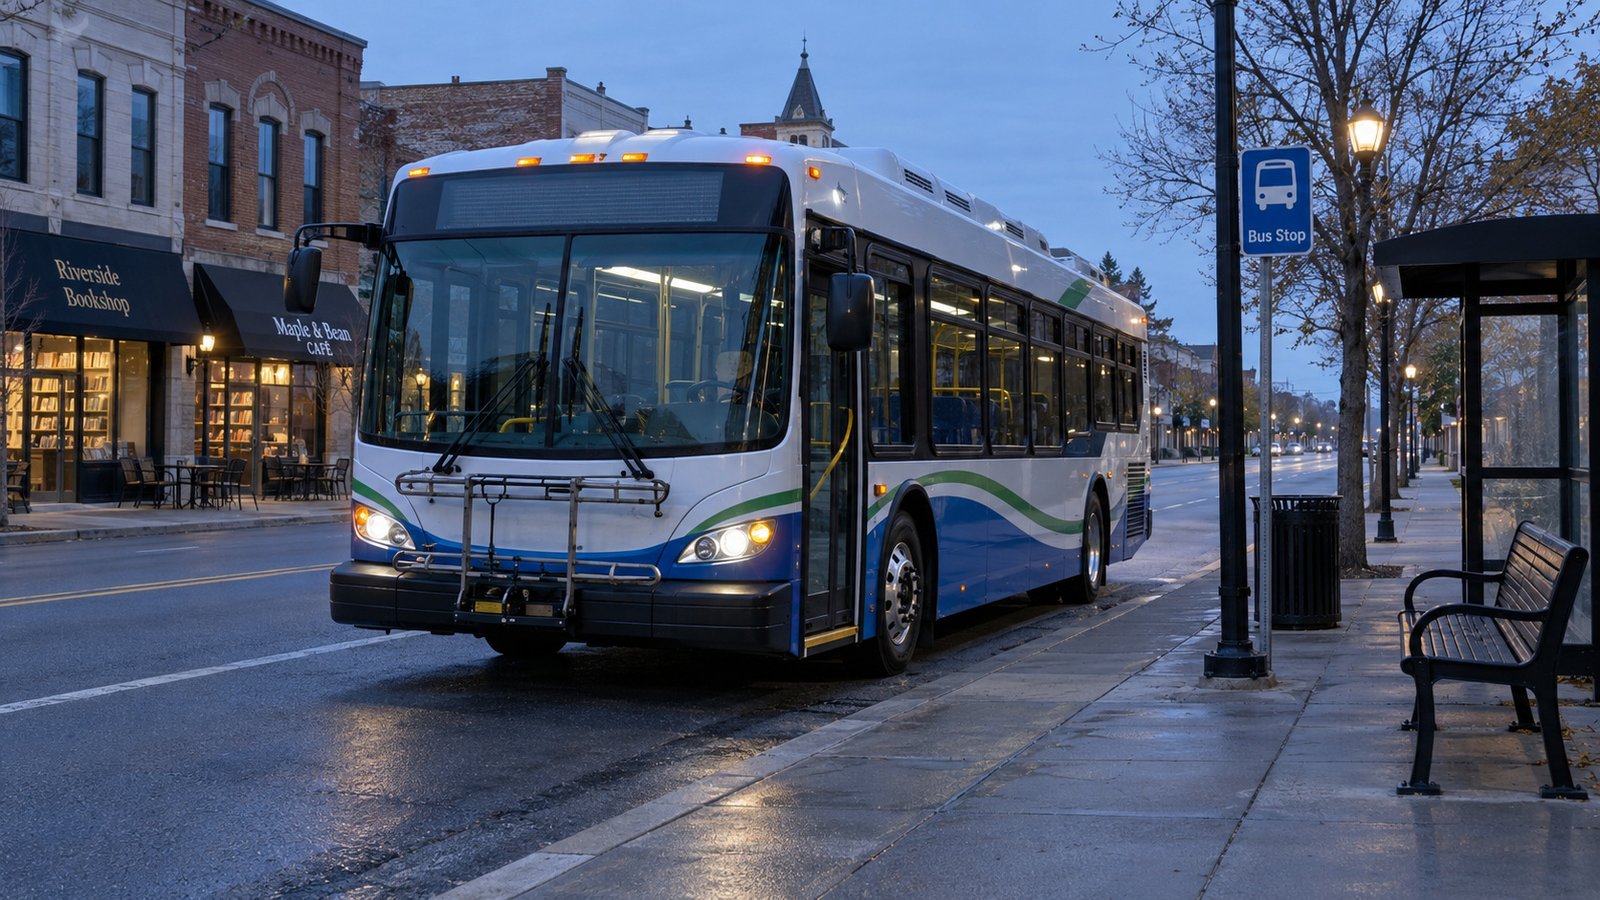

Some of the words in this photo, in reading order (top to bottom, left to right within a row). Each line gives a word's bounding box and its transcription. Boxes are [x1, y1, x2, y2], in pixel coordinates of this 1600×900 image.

[1248, 229, 1272, 243] Bus
[1275, 228, 1306, 244] Stop
[54, 259, 121, 286] Riverside
[63, 286, 130, 317] Bookshop
[272, 316, 311, 341] Maple
[311, 321, 323, 339] &
[322, 322, 352, 341] Bean
[306, 340, 333, 356] CAFÉ
